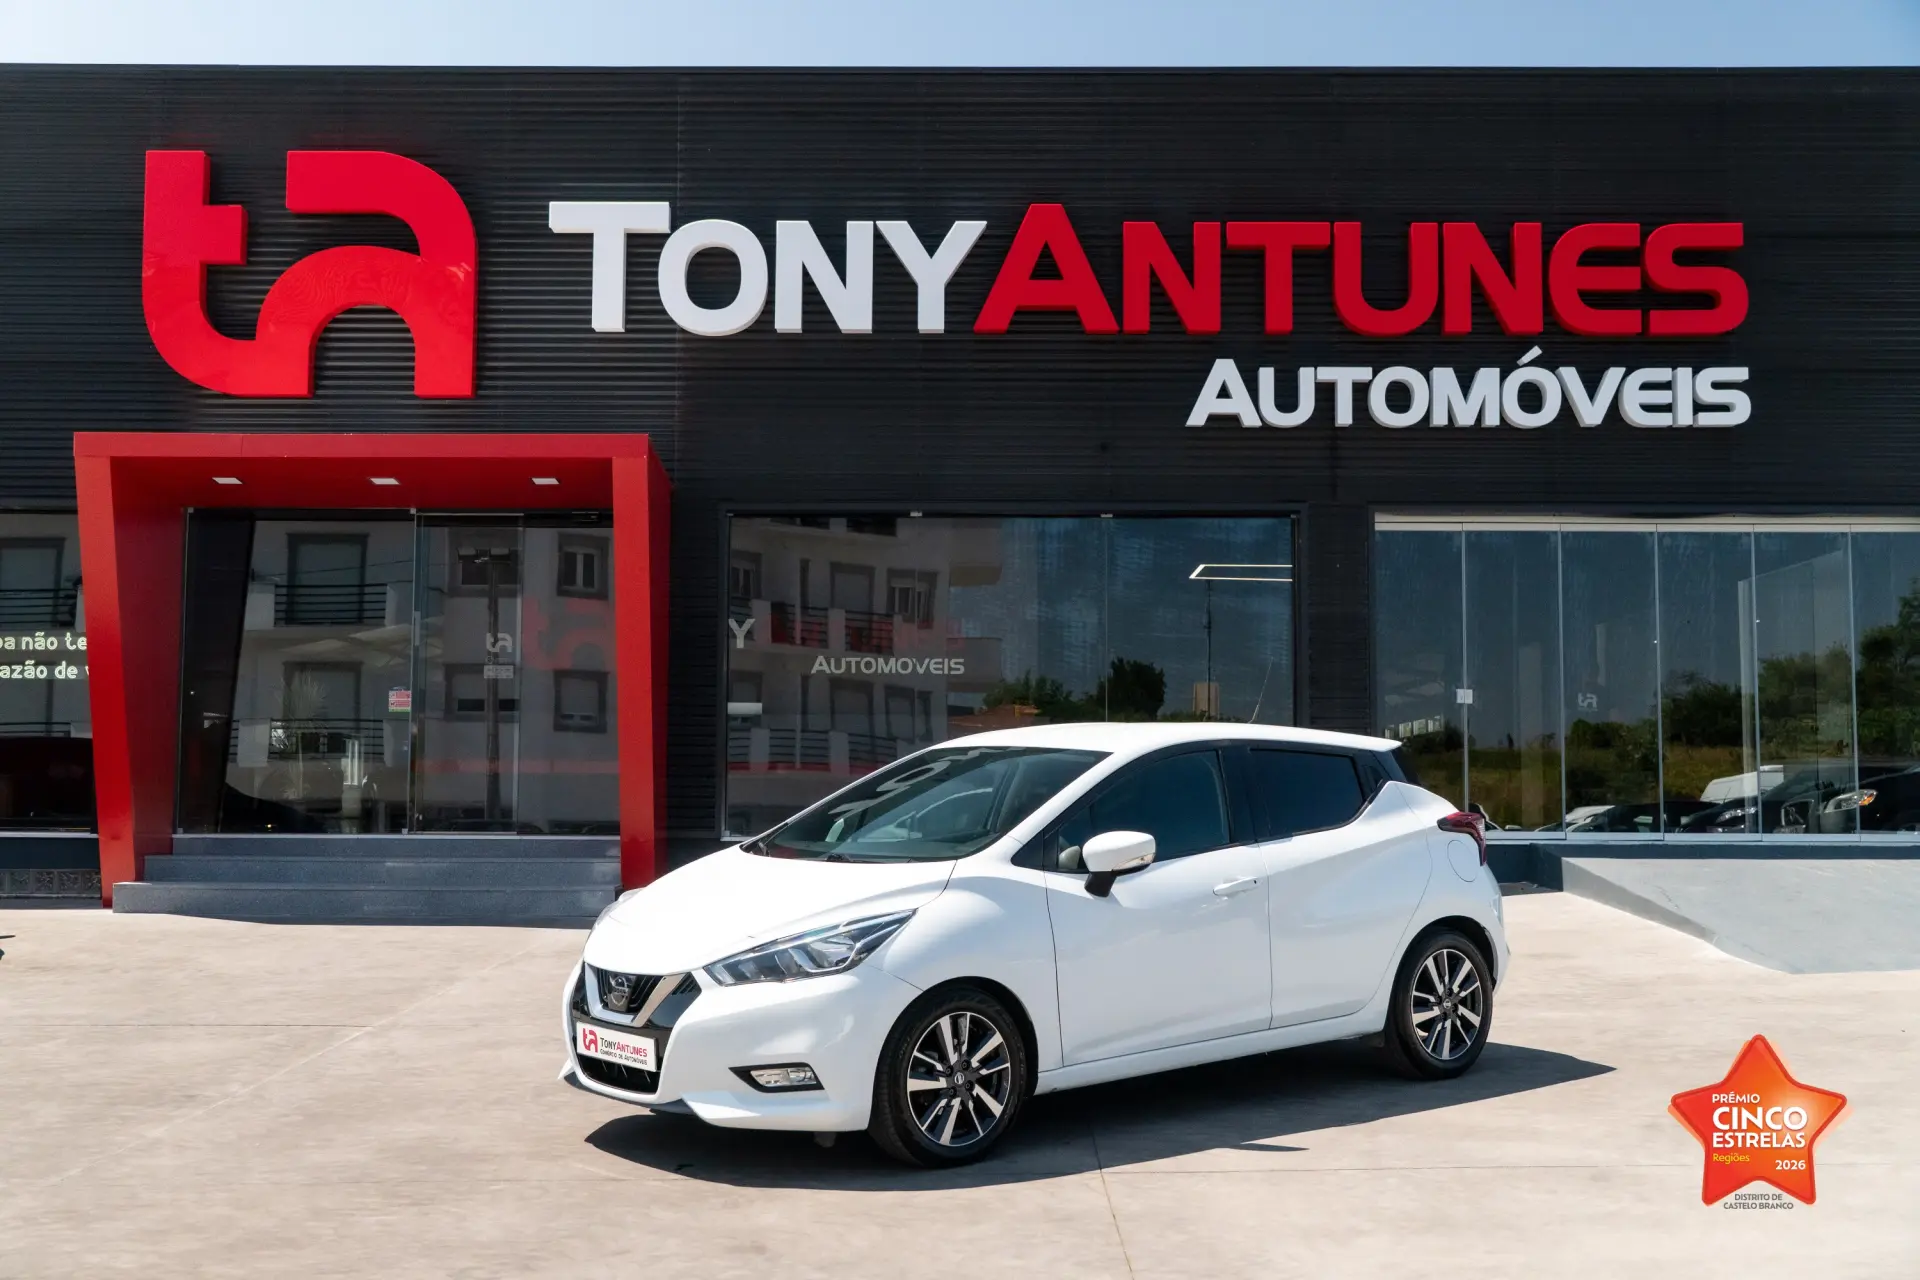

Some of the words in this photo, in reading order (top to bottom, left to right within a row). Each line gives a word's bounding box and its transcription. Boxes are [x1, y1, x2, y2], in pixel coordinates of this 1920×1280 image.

[1185, 345, 1752, 429] AUTOMÓVEIS
[21, 631, 58, 650] não
[0, 660, 48, 679] azão
[54, 660, 78, 679] de
